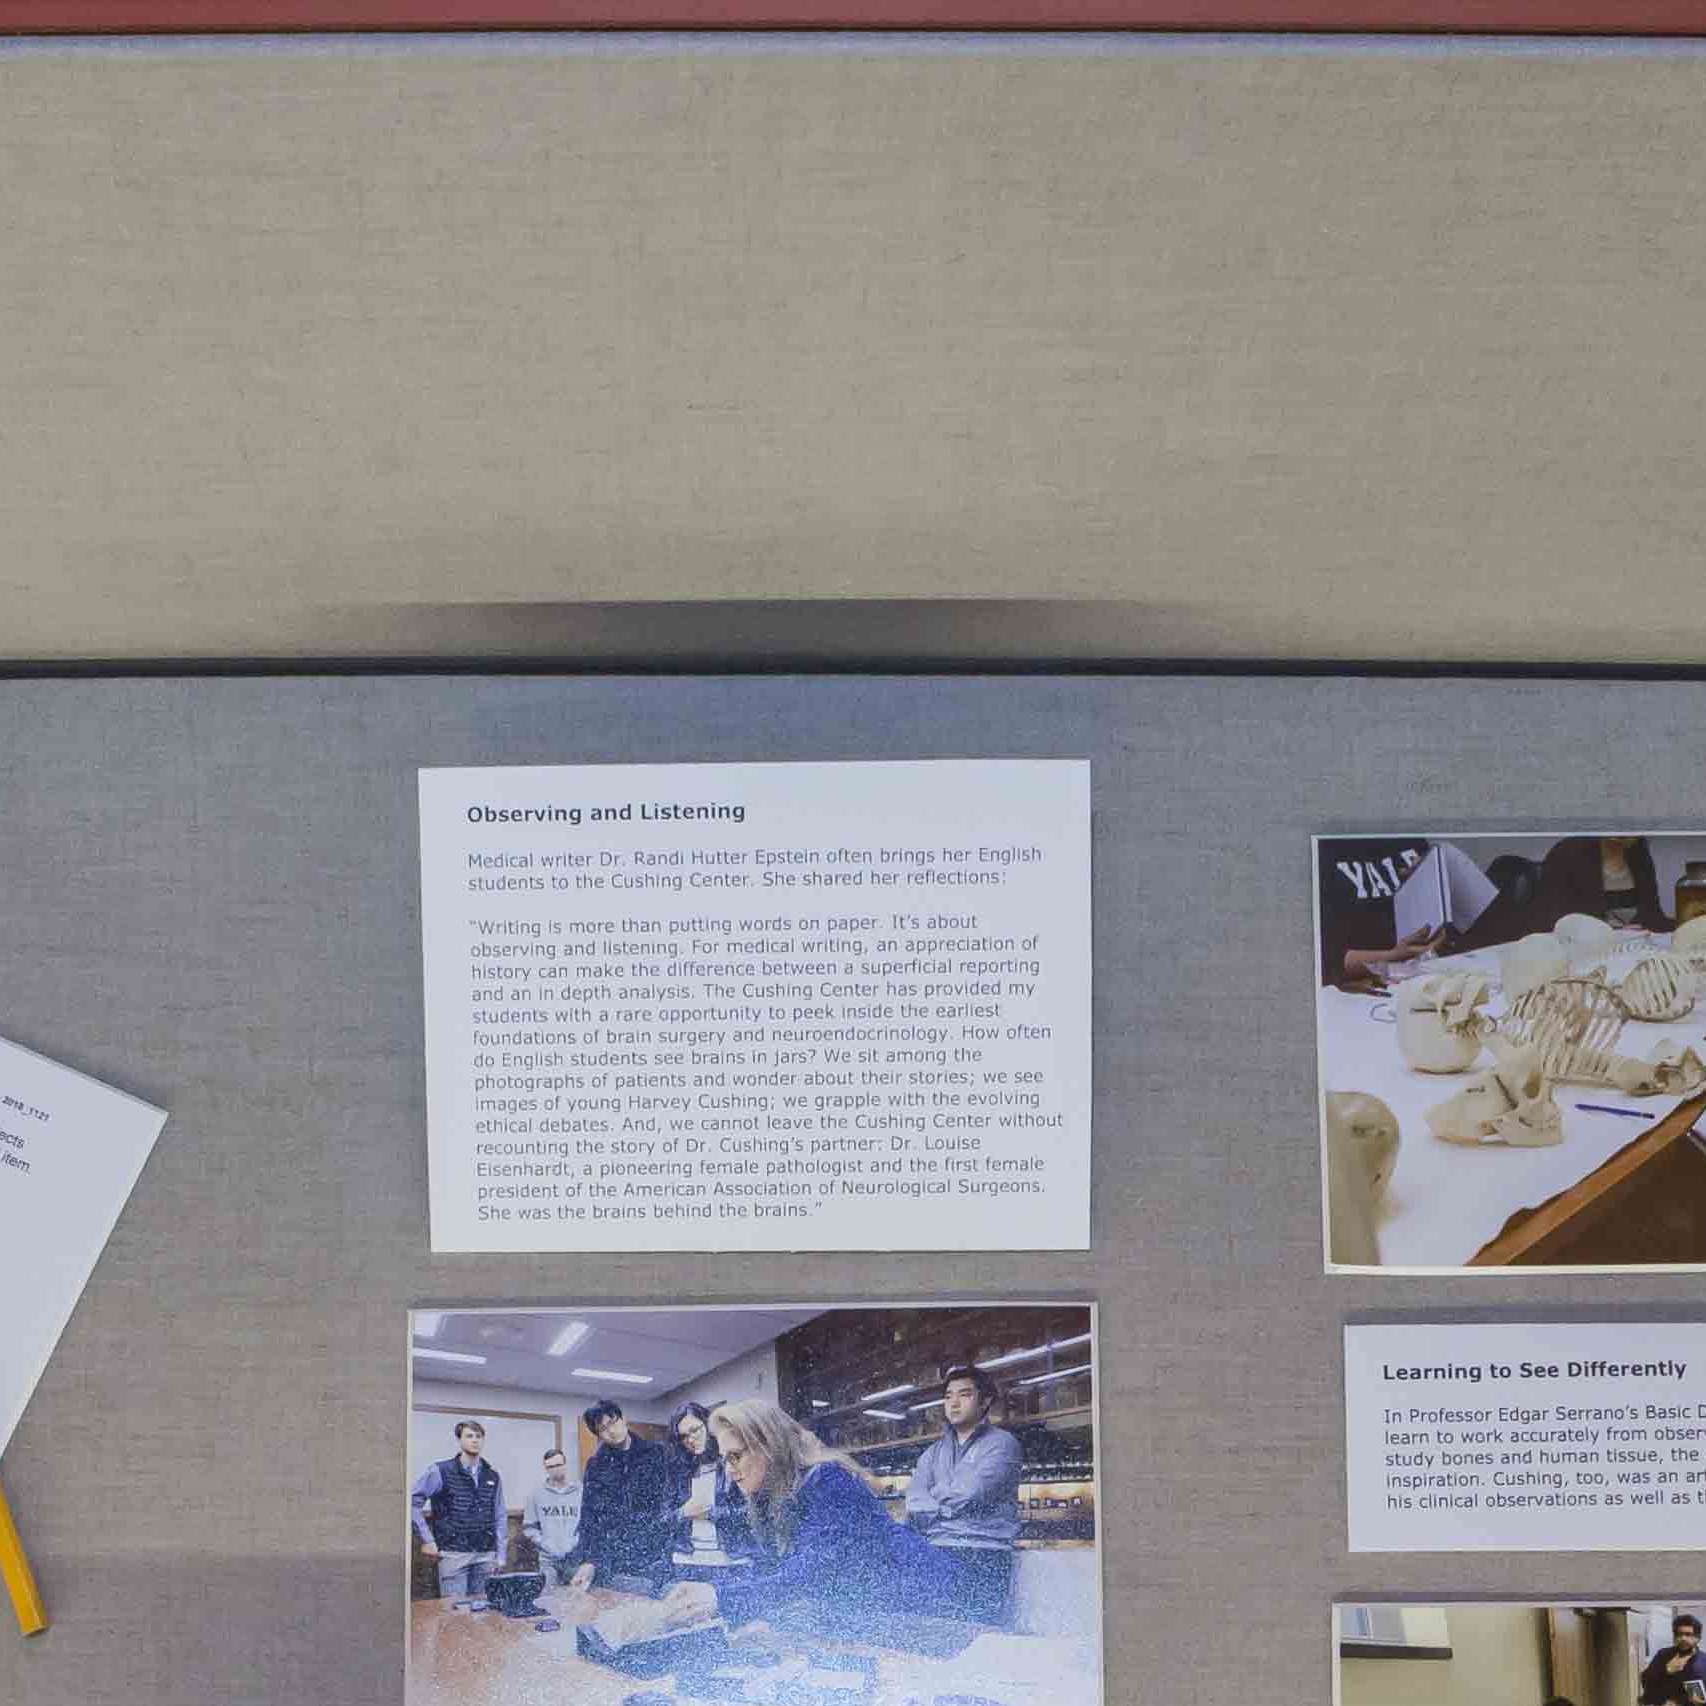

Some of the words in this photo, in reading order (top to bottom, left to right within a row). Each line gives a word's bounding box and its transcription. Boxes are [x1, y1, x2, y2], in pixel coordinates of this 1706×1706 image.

[467, 804, 581, 825] Observing
[590, 803, 631, 821] and
[640, 802, 745, 823] Listening
[468, 852, 533, 869] Medical
[540, 853, 593, 868] writer
[599, 851, 625, 866] Dr.
[634, 850, 684, 866] Randi
[691, 850, 748, 865] Hutter
[755, 848, 819, 867] Epstein
[826, 847, 872, 864] often
[880, 847, 935, 866] brings
[942, 847, 971, 862] her
[979, 847, 1041, 866] English
[1383, 1363, 1481, 1383] Learning
[1489, 1363, 1511, 1379] to
[1519, 1362, 1559, 1378] See
[1567, 1359, 1687, 1380] Differently
[1384, 1408, 1402, 1424] In
[1409, 1407, 1493, 1424] Professor
[1498, 1406, 1549, 1425] Edgar
[1645, 1404, 1691, 1419] Basic
